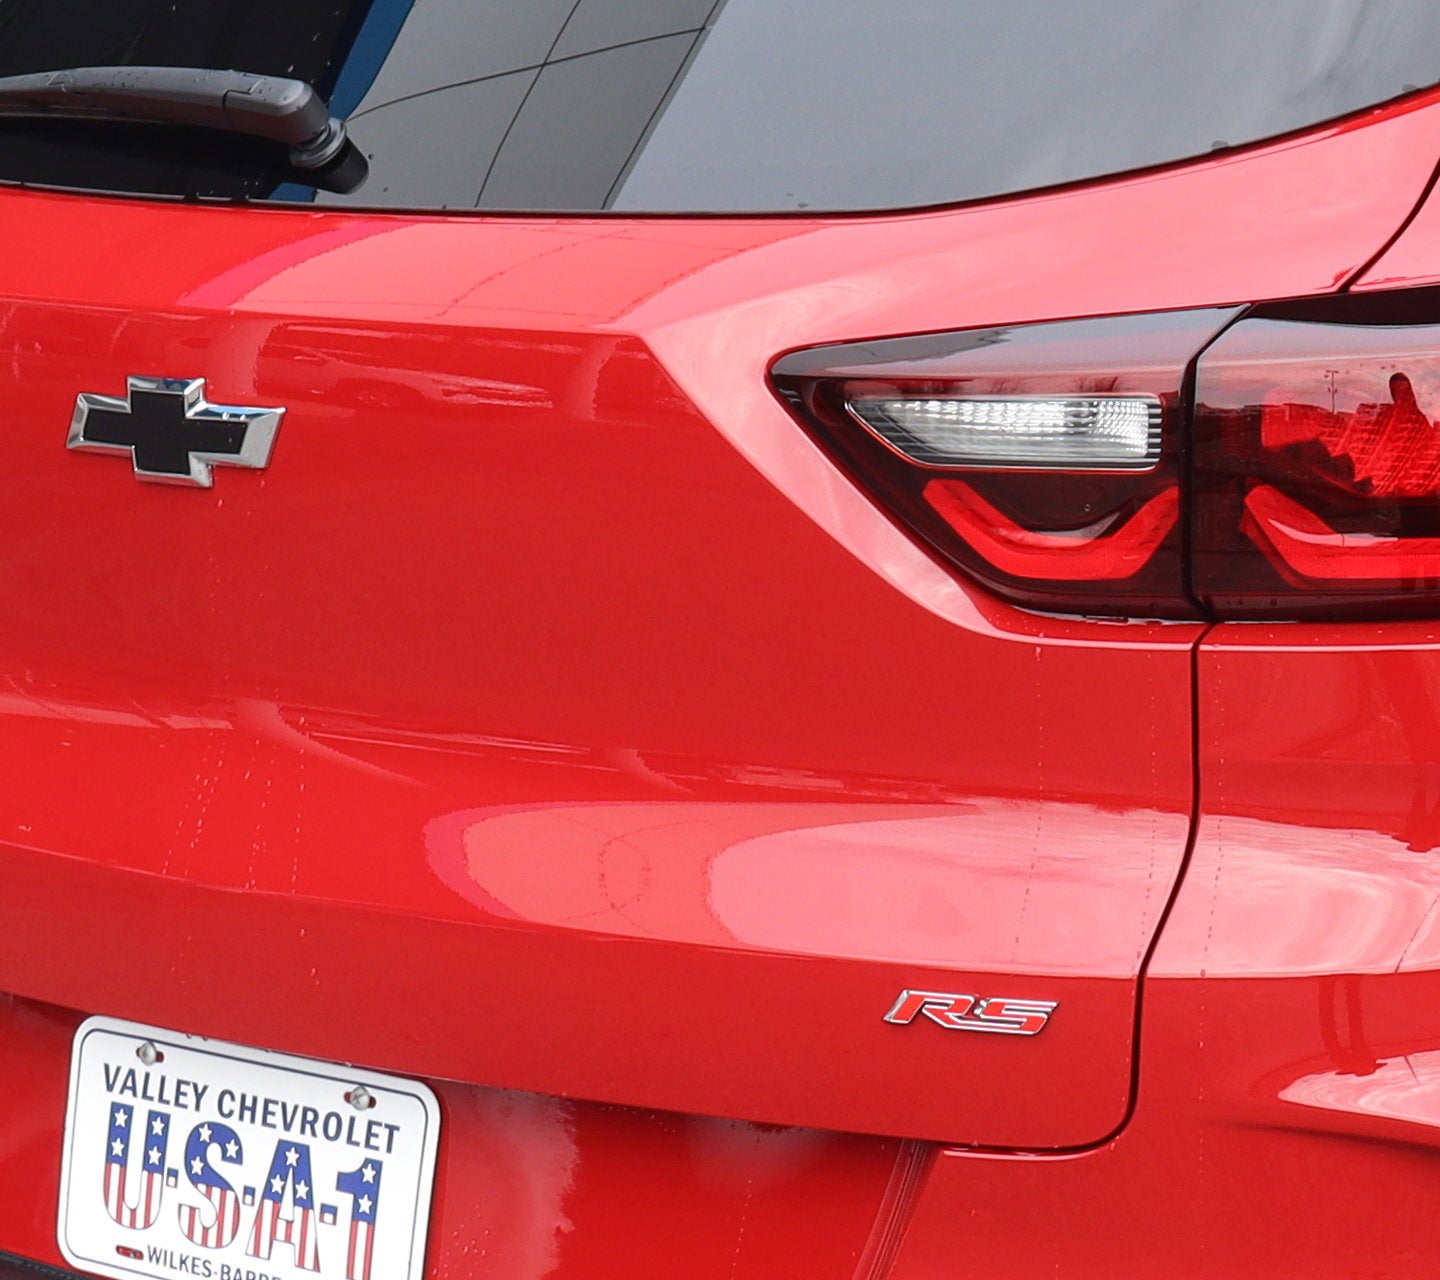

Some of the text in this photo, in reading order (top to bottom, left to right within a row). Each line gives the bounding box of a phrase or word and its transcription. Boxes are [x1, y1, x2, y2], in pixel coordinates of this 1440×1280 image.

[883, 989, 1061, 1035] RS
[103, 1062, 401, 1154] VALLEY CHEVROLET
